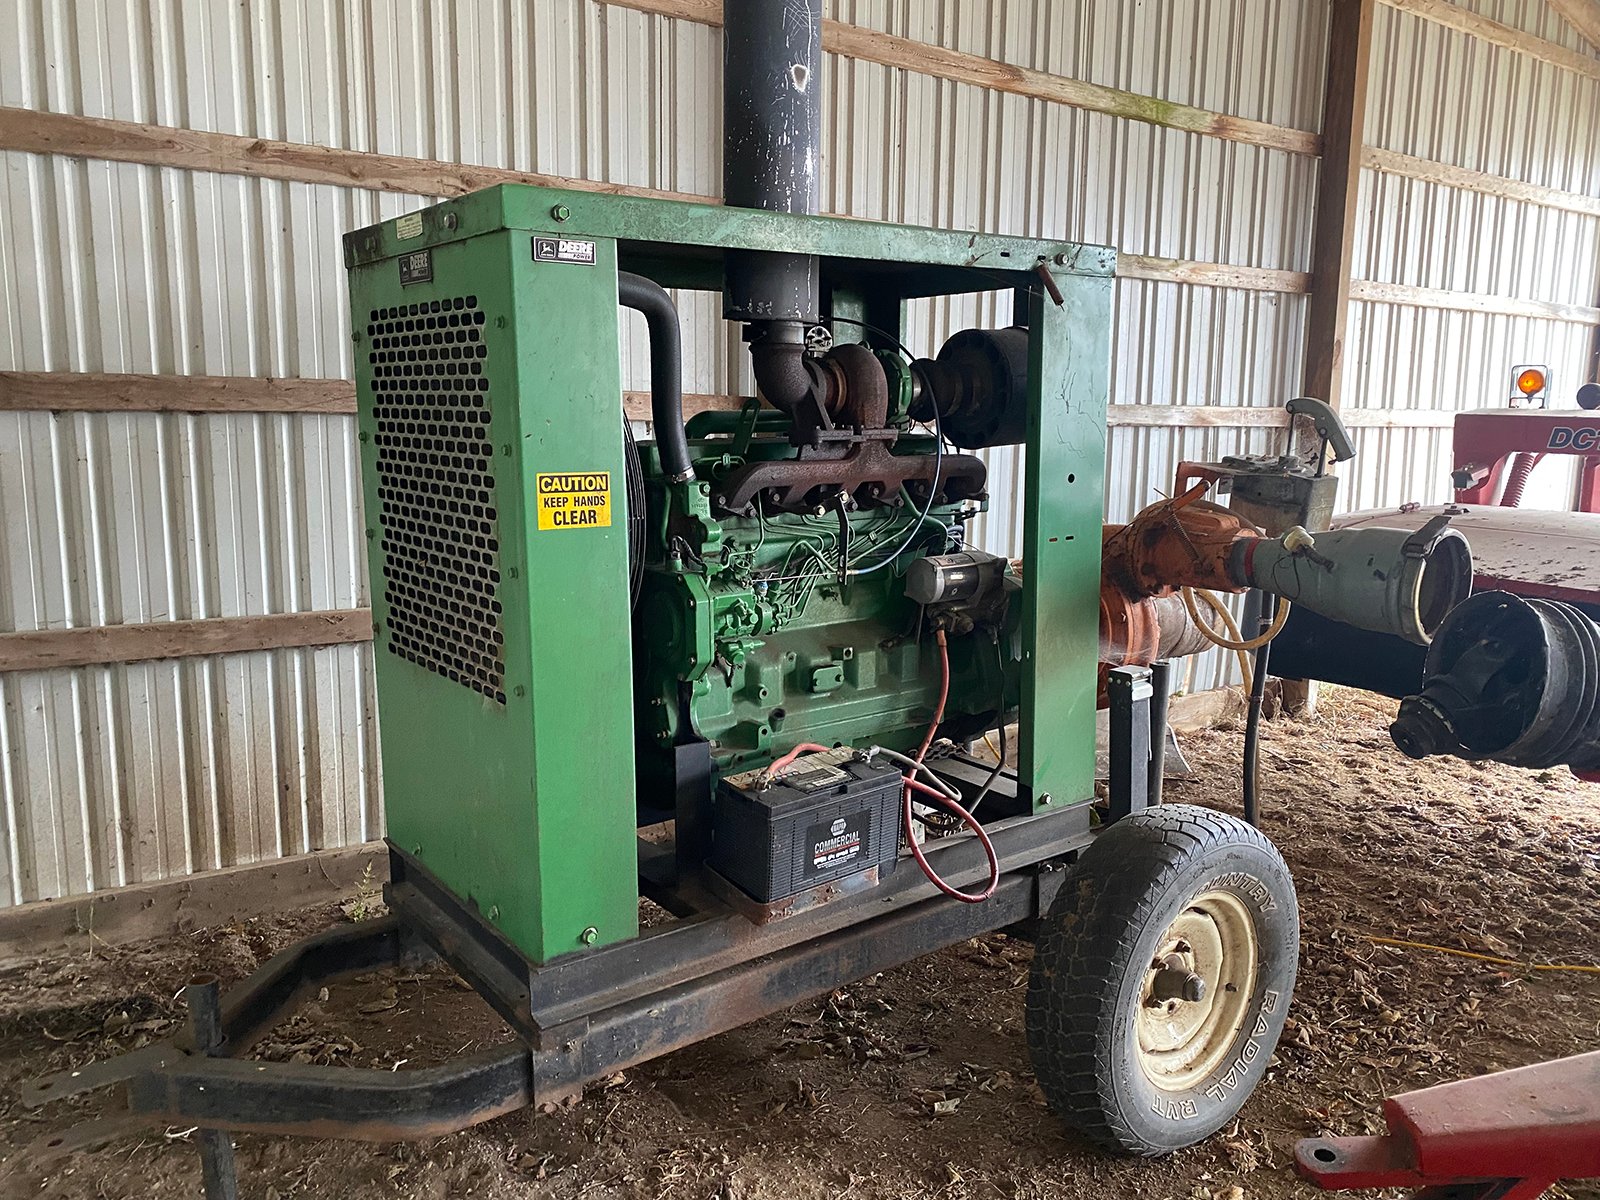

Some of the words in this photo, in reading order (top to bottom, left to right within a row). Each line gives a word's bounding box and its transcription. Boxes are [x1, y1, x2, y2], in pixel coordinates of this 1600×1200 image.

[558, 240, 593, 254] DEERE
[410, 252, 428, 270] DEERE
[1547, 426, 1600, 450] DC
[540, 475, 607, 492] CAUTION
[543, 496, 569, 508] KEEP
[573, 495, 606, 507] HANDS
[553, 509, 597, 526] CLEAR
[814, 830, 861, 854] COMMERCIAL
[1205, 990, 1279, 1101] RADIAL
[1151, 1094, 1198, 1120] RVT
